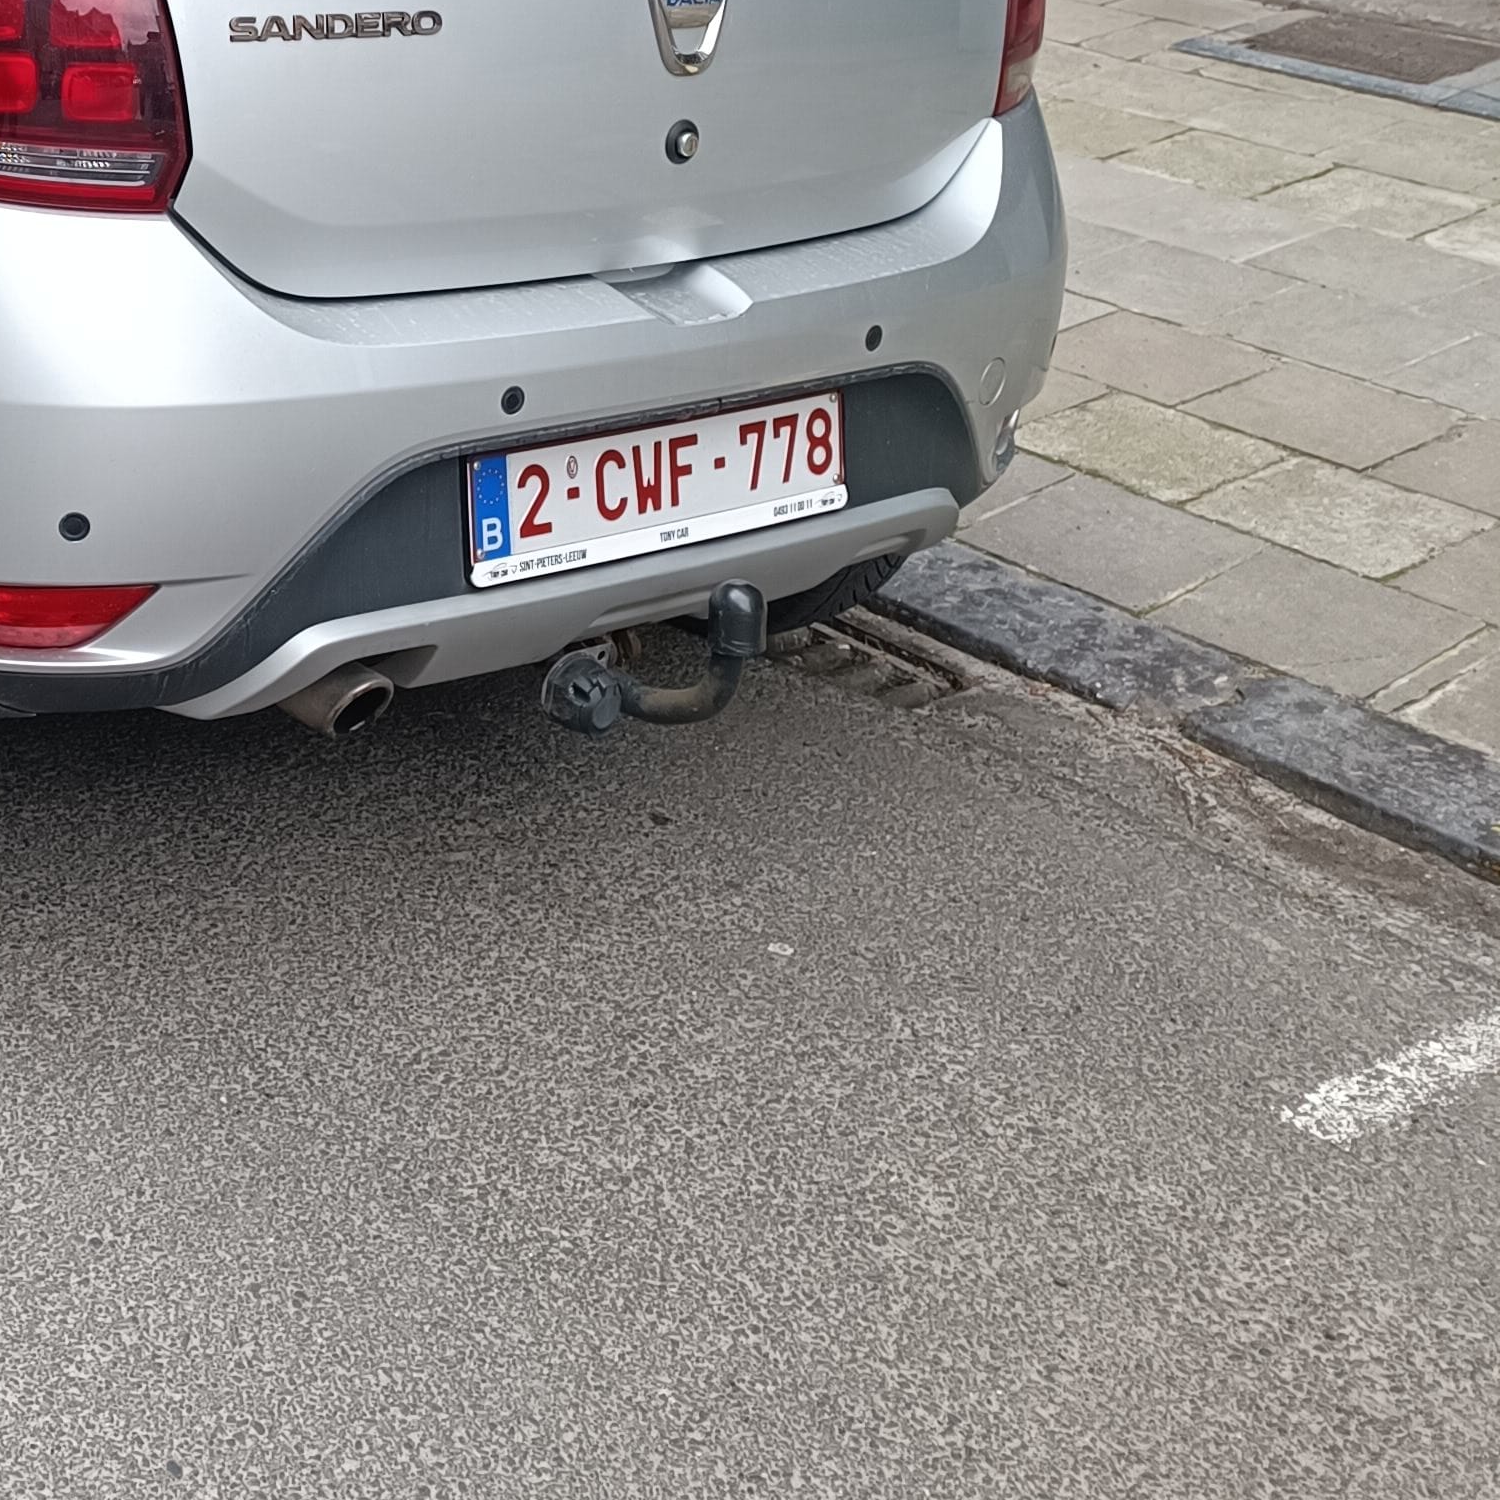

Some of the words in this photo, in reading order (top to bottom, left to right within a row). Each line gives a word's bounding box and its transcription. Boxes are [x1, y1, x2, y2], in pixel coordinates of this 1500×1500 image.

[228, 10, 443, 42] SANDERO
[516, 407, 834, 539] 2-CWF-778
[481, 516, 504, 552] B
[660, 530, 676, 543] TONY
[676, 527, 689, 539] CAR
